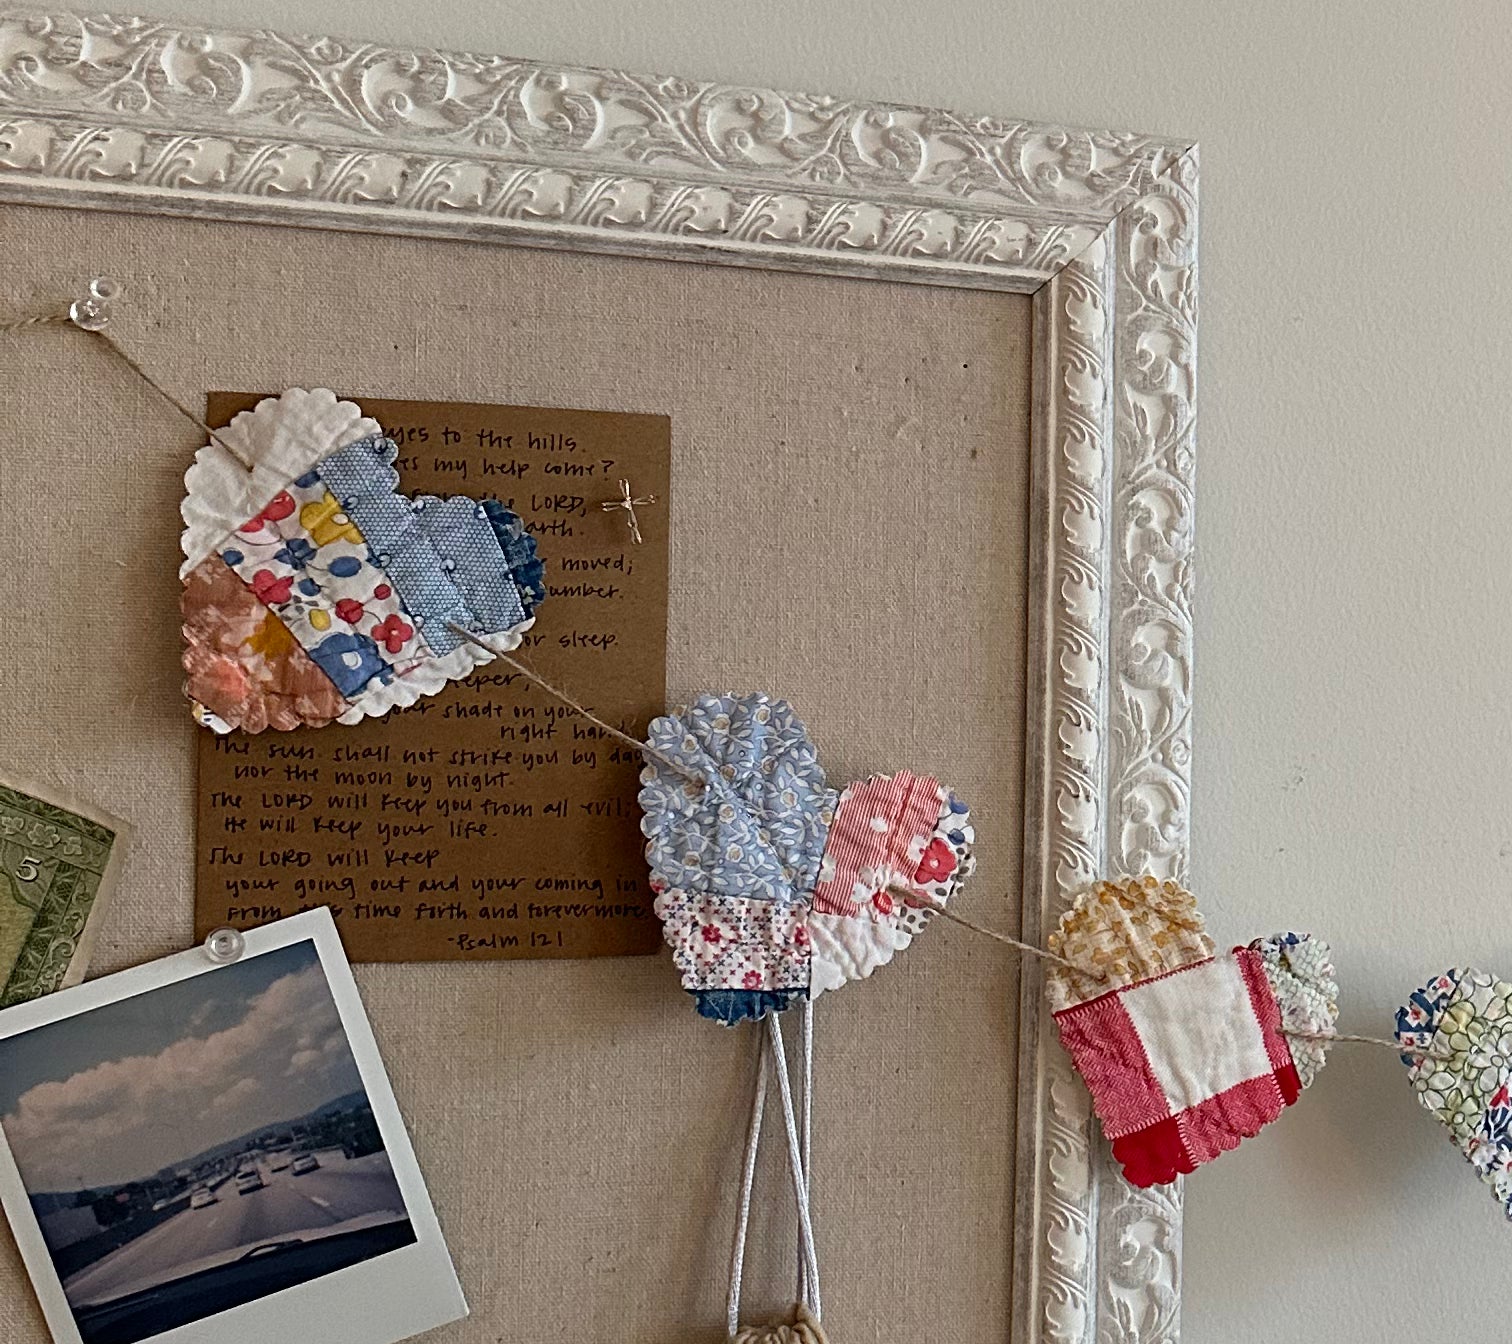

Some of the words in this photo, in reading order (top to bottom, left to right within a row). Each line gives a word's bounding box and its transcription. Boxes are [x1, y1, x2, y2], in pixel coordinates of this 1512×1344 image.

[442, 427, 461, 444] to
[477, 428, 512, 448] the
[434, 459, 467, 479] my
[483, 459, 529, 478] help
[524, 520, 584, 536] arth.
[443, 702, 503, 718] shade
[514, 707, 534, 718] on
[501, 723, 557, 742] right
[215, 735, 250, 754] The
[269, 744, 314, 759] sun
[333, 745, 389, 762] shall
[403, 747, 440, 764] not
[449, 748, 512, 765] strike
[522, 751, 558, 771] you
[572, 749, 597, 768] by
[235, 765, 274, 779] nor
[284, 765, 319, 781] the
[335, 771, 391, 785] moon
[407, 772, 431, 793] by
[211, 792, 242, 807] The
[262, 793, 313, 810] LORD
[328, 793, 367, 808] will
[436, 799, 472, 816] you
[481, 799, 532, 816] from
[543, 800, 567, 817] all
[225, 816, 247, 832] He
[260, 815, 295, 832] will
[378, 823, 433, 845] your
[209, 846, 243, 865] The
[259, 849, 311, 867] LORD
[327, 849, 368, 866] will
[16, 855, 41, 882] 5
[226, 879, 279, 897] your
[294, 876, 355, 899] going
[371, 876, 410, 892] out
[419, 875, 459, 892] and
[472, 876, 526, 900] your
[535, 876, 603, 900] coming
[616, 874, 637, 891] in
[355, 900, 401, 919] time
[416, 902, 467, 919] forth
[479, 906, 518, 919] and
[531, 931, 562, 947] 121
